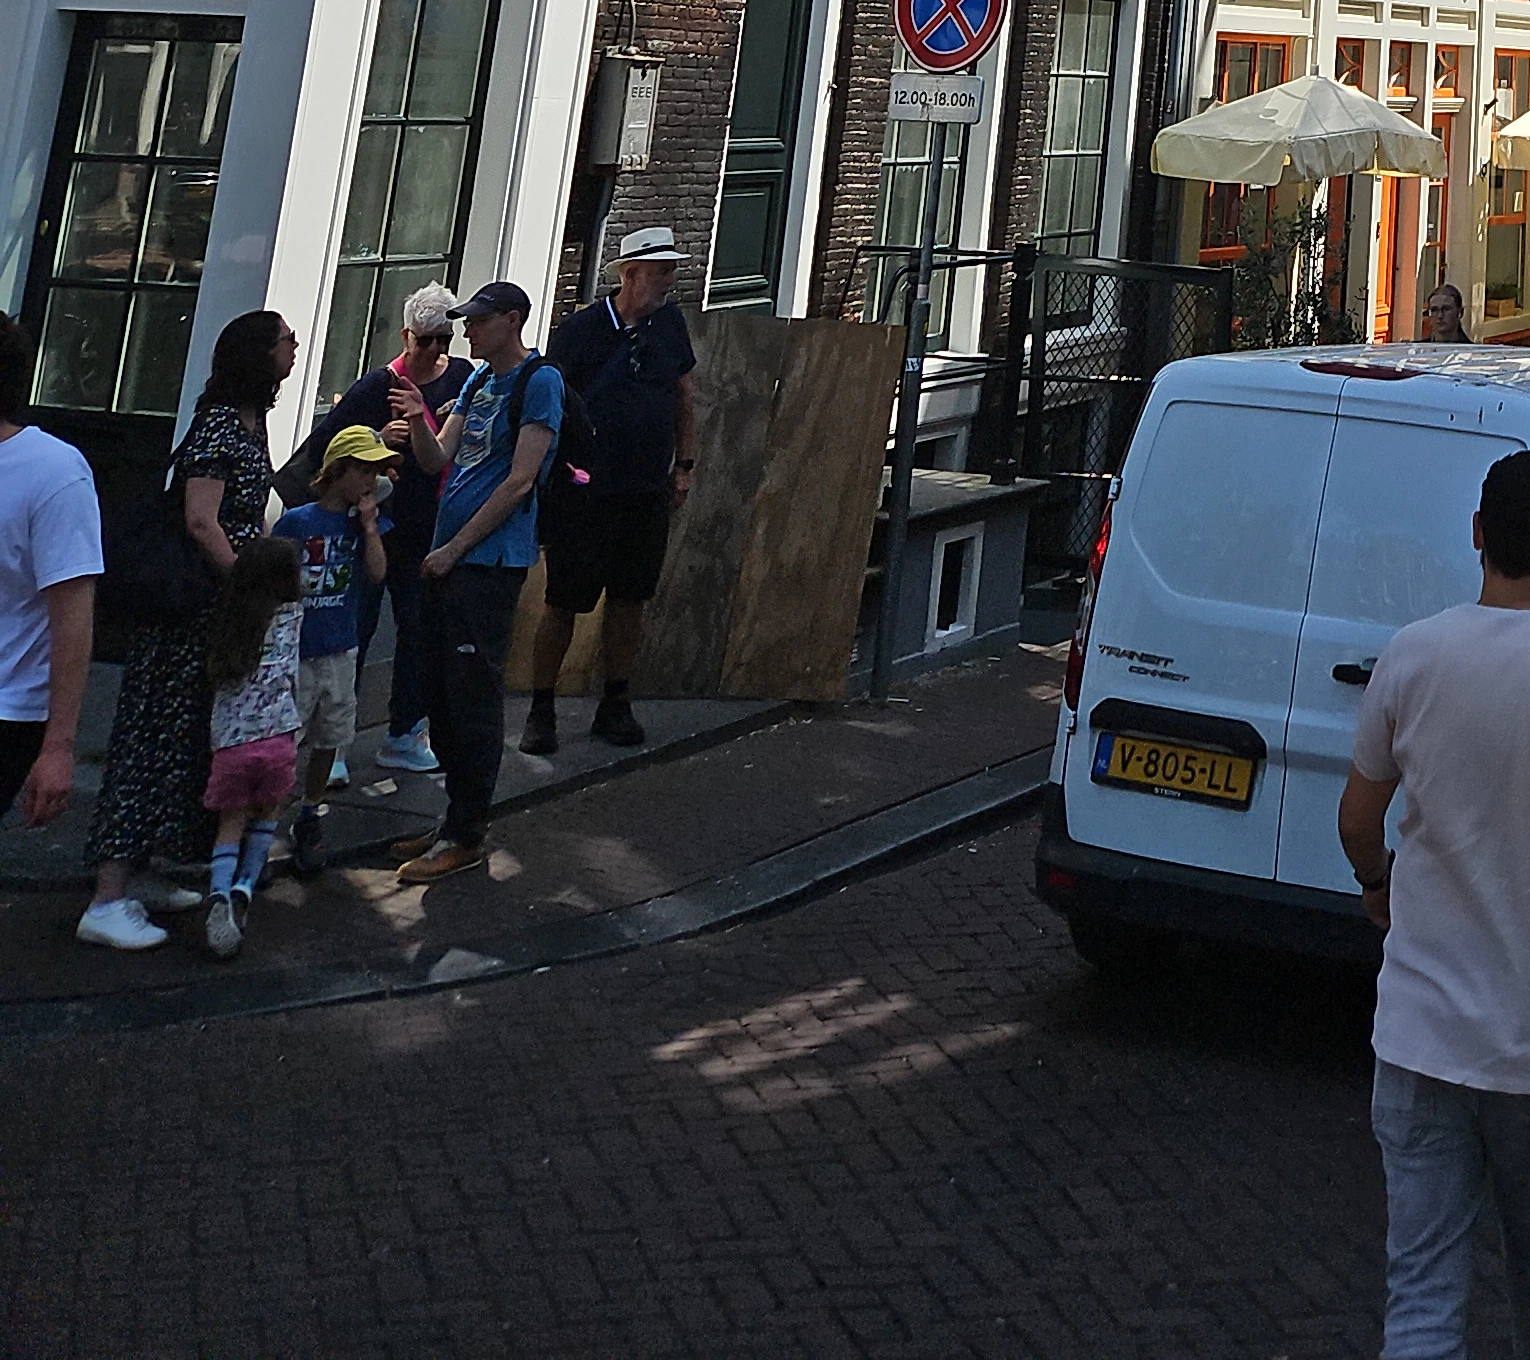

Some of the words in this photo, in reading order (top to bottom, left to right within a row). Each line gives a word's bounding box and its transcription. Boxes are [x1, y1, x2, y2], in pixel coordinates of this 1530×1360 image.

[894, 90, 976, 108] 12.00-18.00h
[1098, 644, 1174, 668] TRANSIT
[1128, 665, 1190, 682] CONNECT
[1119, 743, 1238, 794] V-805-LL
